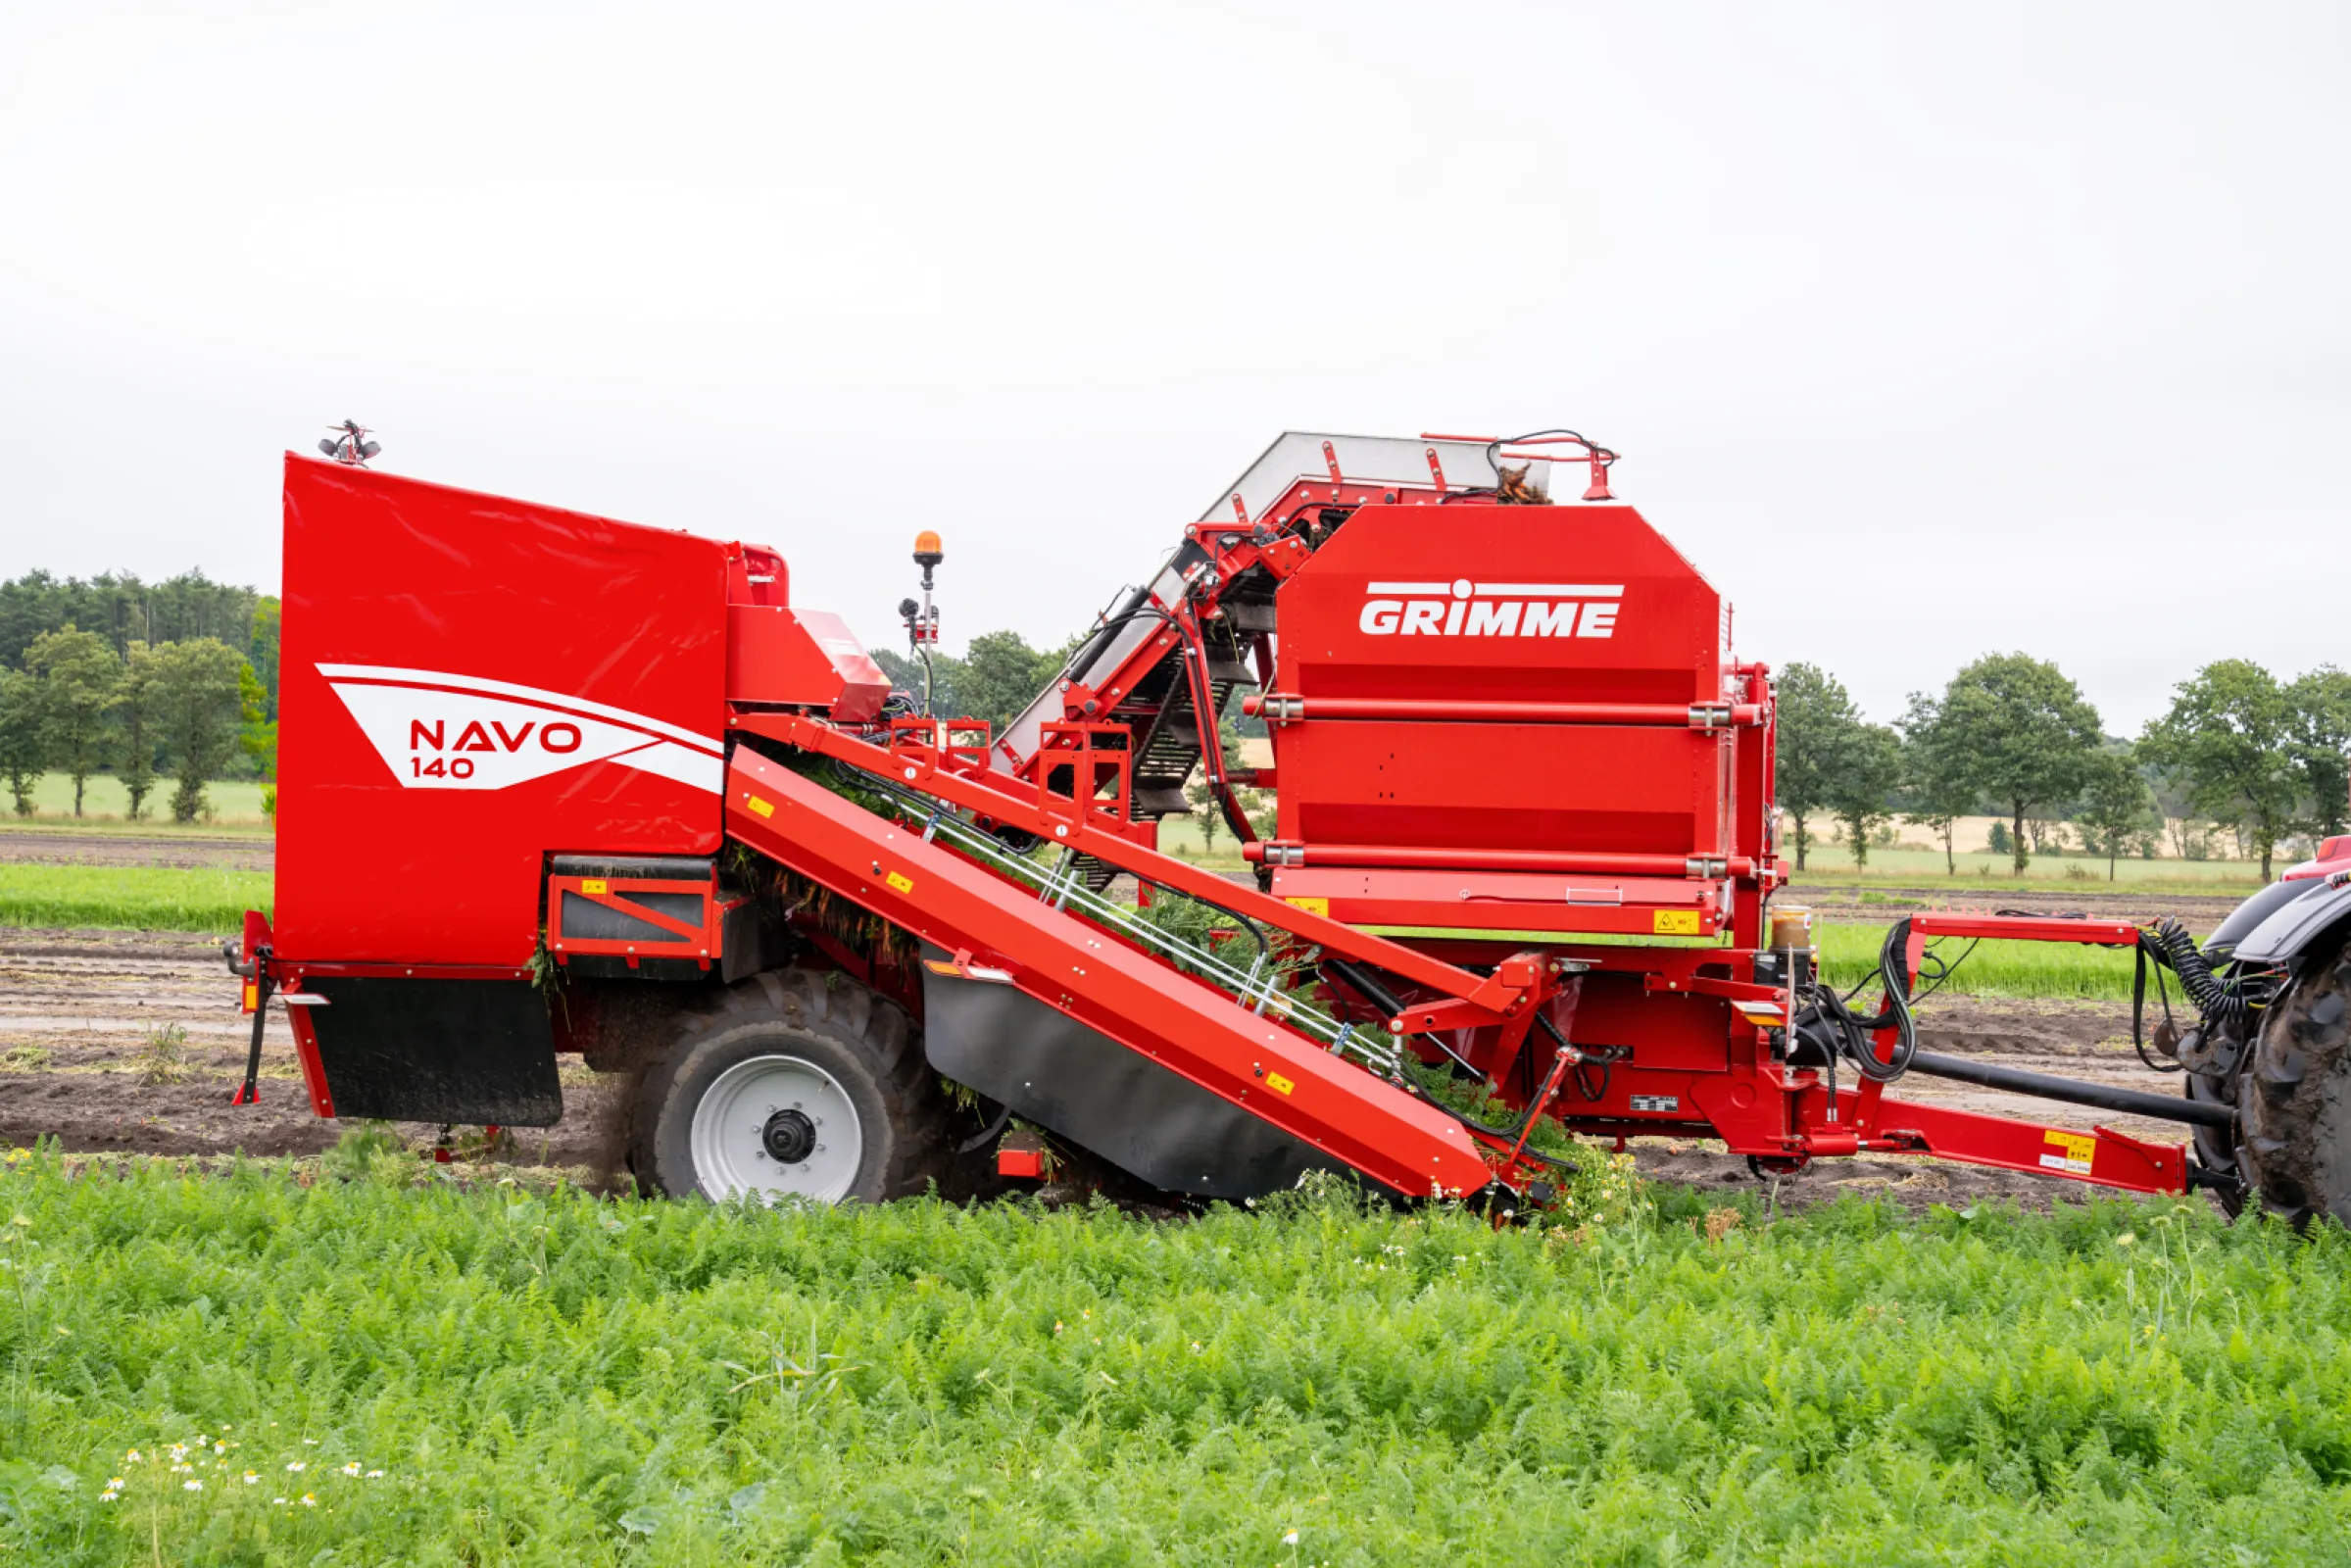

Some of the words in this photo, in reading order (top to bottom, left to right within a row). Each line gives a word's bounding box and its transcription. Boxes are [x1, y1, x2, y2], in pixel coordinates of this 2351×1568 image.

[1358, 578, 1620, 638] GRIMME
[410, 718, 583, 754] NAVO
[410, 757, 474, 779] 140
